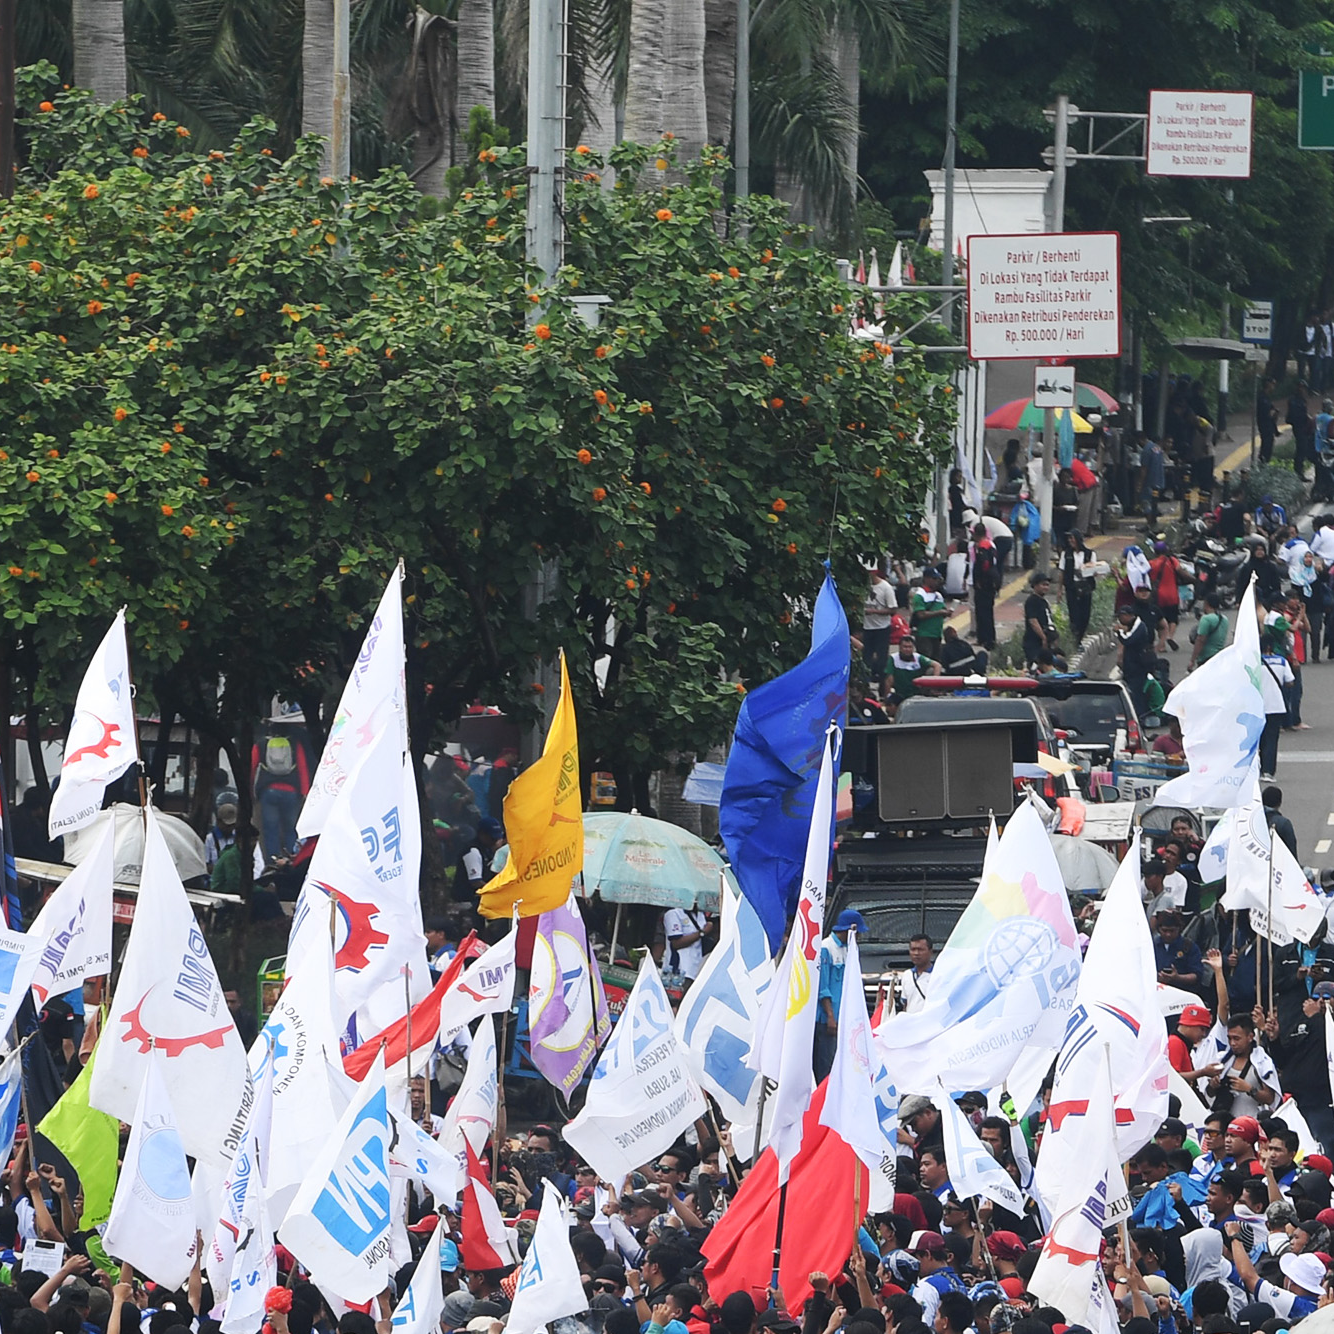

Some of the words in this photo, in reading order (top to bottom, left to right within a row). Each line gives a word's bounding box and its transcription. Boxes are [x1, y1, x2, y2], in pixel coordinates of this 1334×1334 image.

[1007, 251, 1034, 264] Parkir
[1036, 251, 1041, 265] /
[1042, 249, 1081, 263] Berhenti
[980, 272, 989, 285] Di
[990, 271, 1019, 284] Lokasi
[1020, 272, 1042, 287] Yang
[1044, 270, 1068, 284] Tidak
[1070, 269, 1110, 285] Terdapat
[994, 292, 1025, 305] Rambu
[1025, 290, 1063, 304] Fasilitas
[1064, 289, 1092, 303] Parkir
[974, 311, 1020, 325] Dikenakan
[1021, 309, 1061, 323] Retribusi
[1062, 308, 1115, 322] Penderekan
[1005, 330, 1019, 344] Rp.
[1021, 329, 1058, 342] 500.000
[1059, 327, 1065, 343] /
[1066, 327, 1085, 341] Hari
[1245, 325, 1269, 334] STOP
[624, 855, 667, 866] Minerale
[284, 1005, 304, 1031] DAN
[272, 1031, 307, 1097] KOMPONEN
